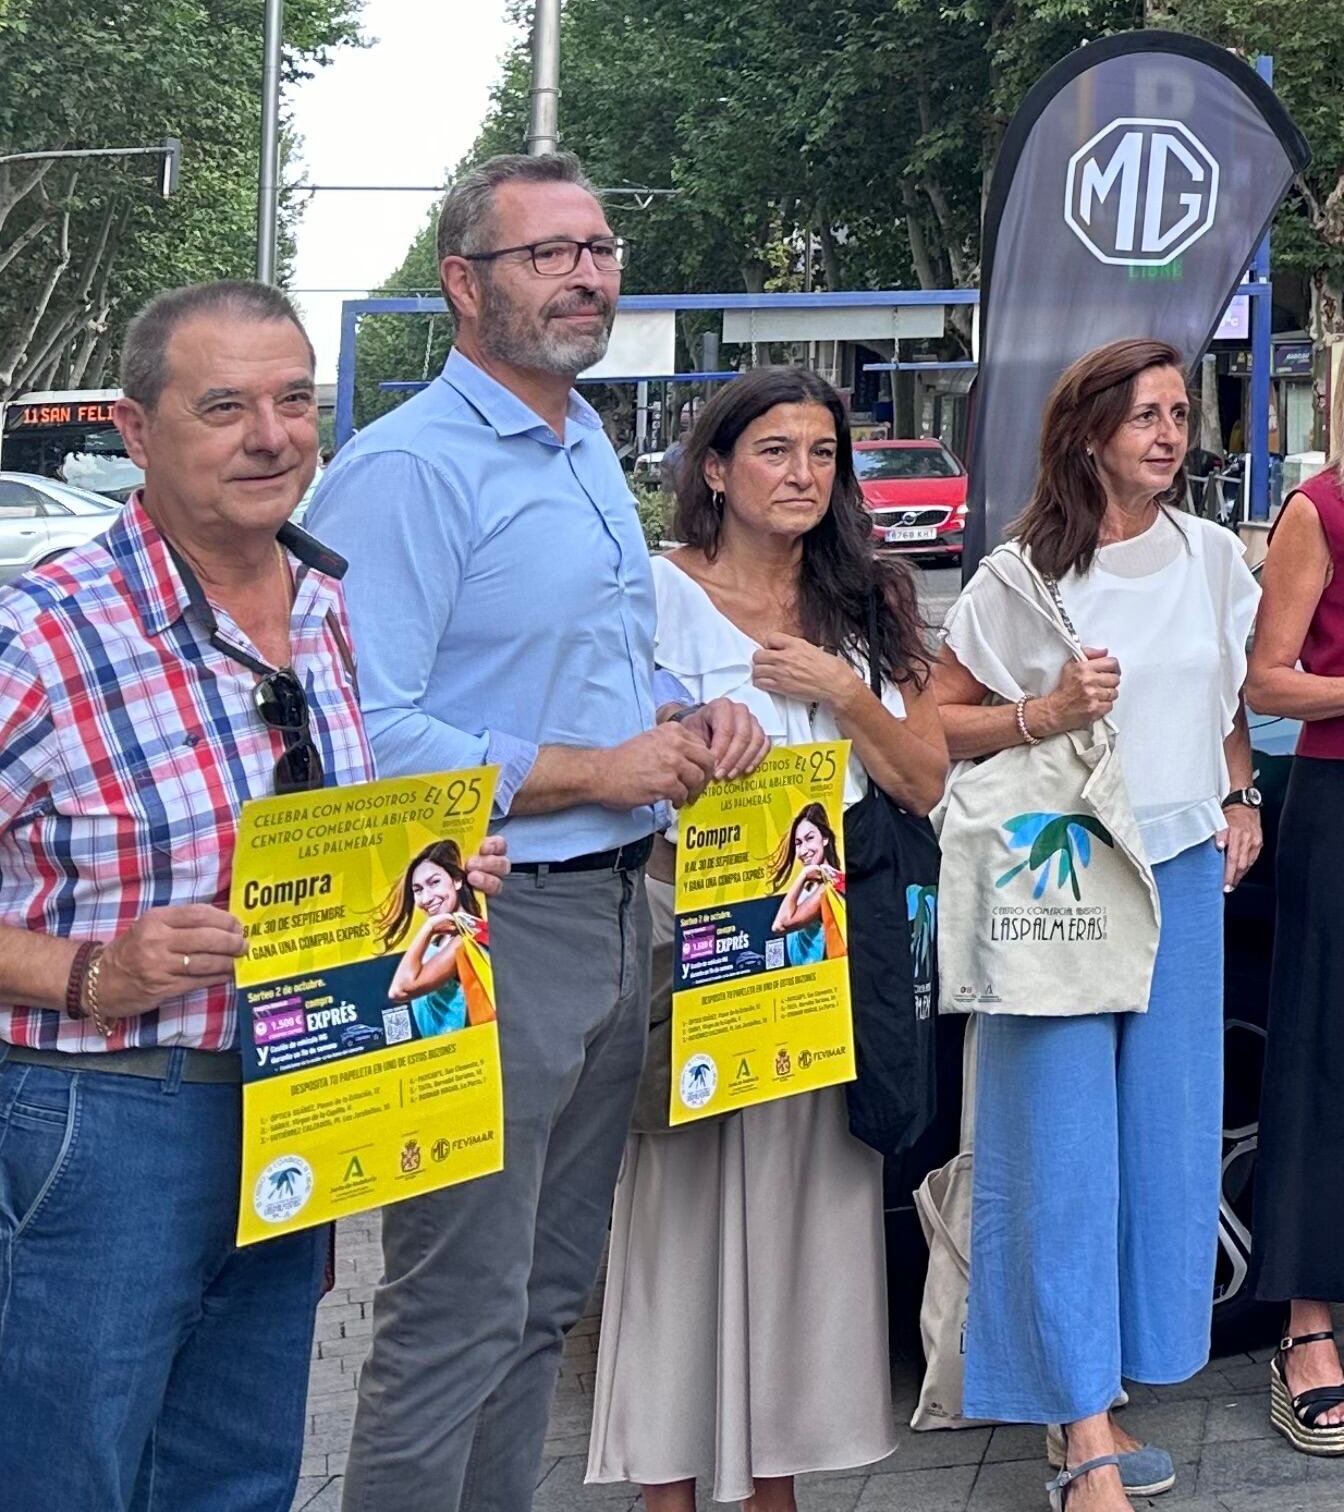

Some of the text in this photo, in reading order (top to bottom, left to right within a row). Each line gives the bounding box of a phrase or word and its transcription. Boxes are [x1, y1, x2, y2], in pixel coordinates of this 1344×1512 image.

[1079, 131, 1204, 253] MG
[24, 409, 38, 423] 11
[41, 407, 70, 422] SAN
[810, 751, 836, 782] 25
[254, 778, 481, 828] CELEBRA CON NOSOTROS EL 25
[251, 806, 434, 848] CENTRO COMERCIAL ABIERTO
[686, 824, 741, 850] Compra
[298, 832, 382, 859] LAS PALMERAS
[244, 873, 331, 910] Compra
[250, 922, 262, 937] AL
[264, 919, 276, 933] 30
[291, 904, 345, 927] SEPTIEMBRE
[252, 921, 370, 959] GANA UNA COMPRA EXPRÉS
[715, 929, 750, 954] EXPRÉS
[307, 998, 357, 1032] EXPRÉS
[451, 1130, 493, 1151] FEVIMAR
